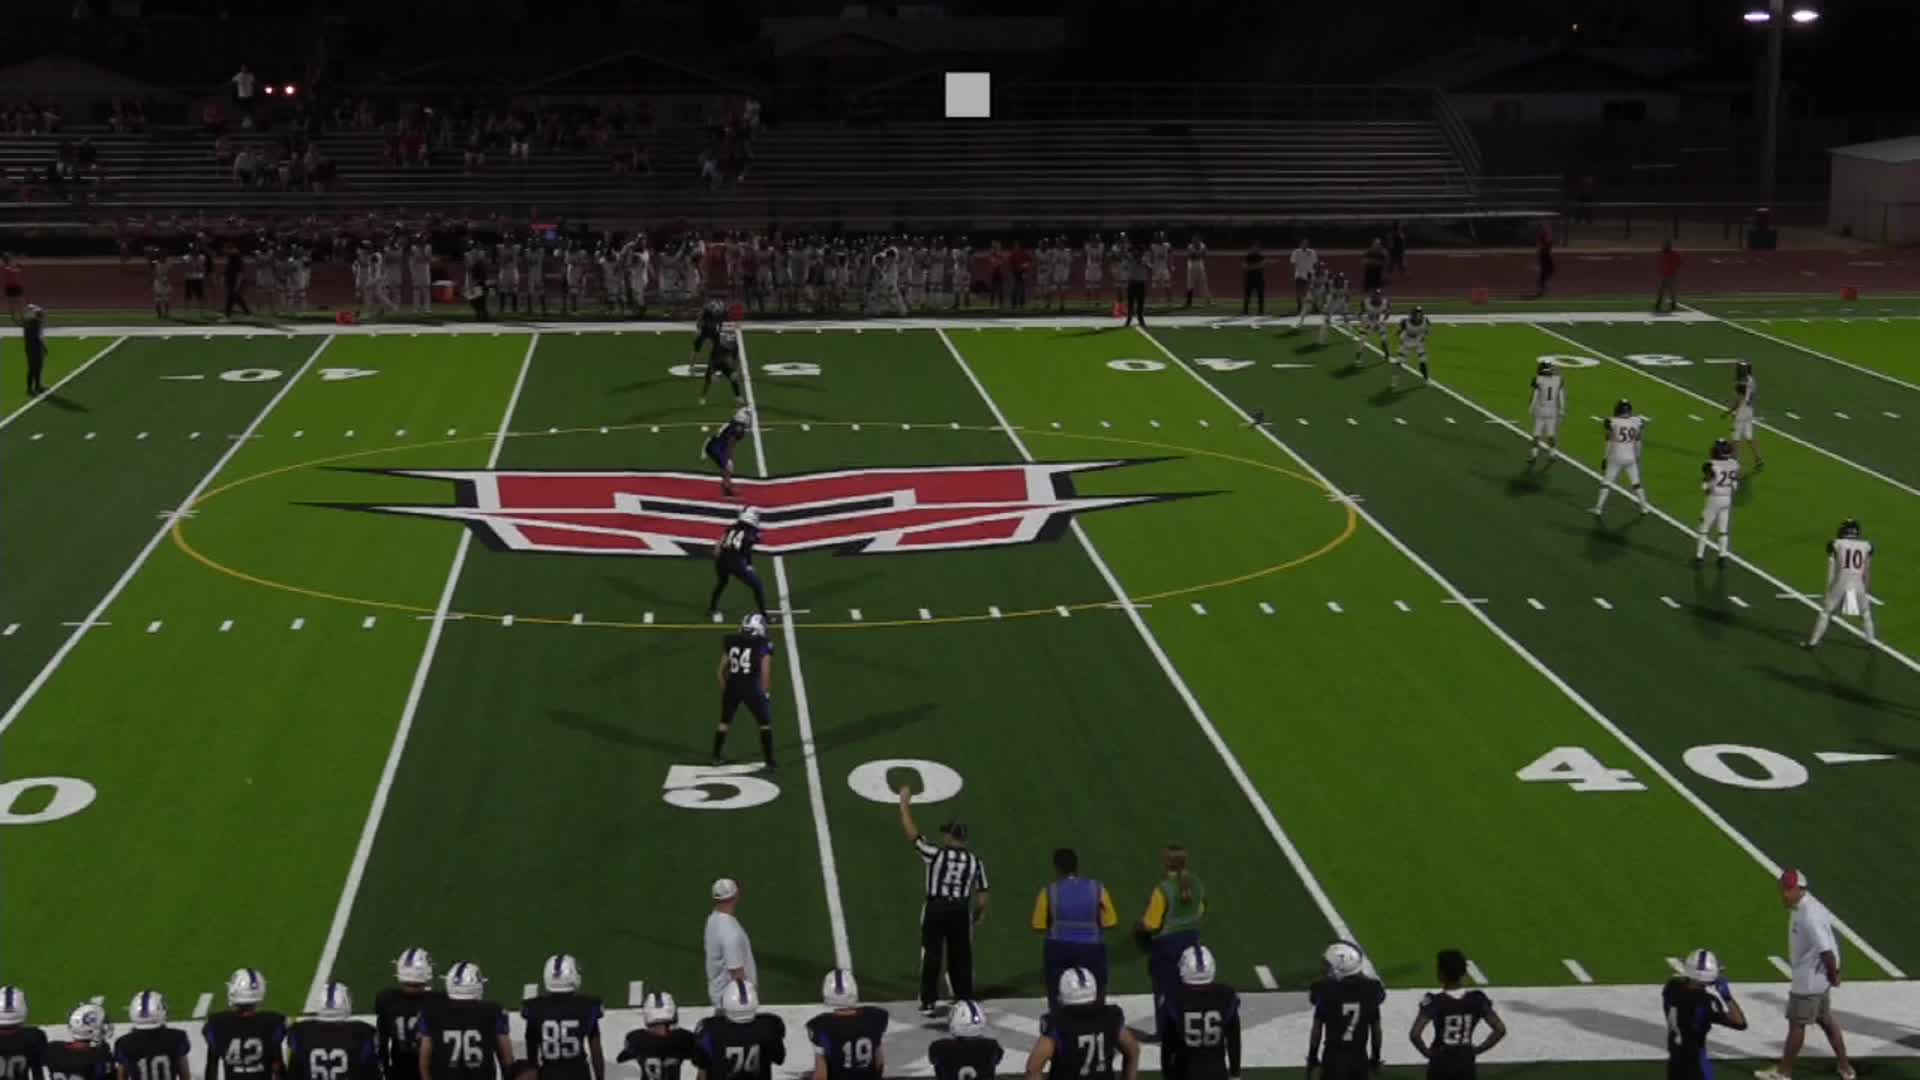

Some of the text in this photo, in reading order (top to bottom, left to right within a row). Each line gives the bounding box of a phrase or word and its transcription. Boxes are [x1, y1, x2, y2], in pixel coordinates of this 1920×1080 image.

[1843, 549, 1863, 569] 10
[729, 646, 752, 674] 64
[541, 1020, 580, 1059] 85
[1183, 1010, 1222, 1048] 56
[1341, 1002, 1361, 1041] 7
[225, 1038, 265, 1074] 42
[310, 1048, 349, 1080] 62
[443, 1029, 484, 1068] 76
[841, 1037, 873, 1069] 19
[1077, 1032, 1105, 1077] 71
[136, 1054, 173, 1080] 10
